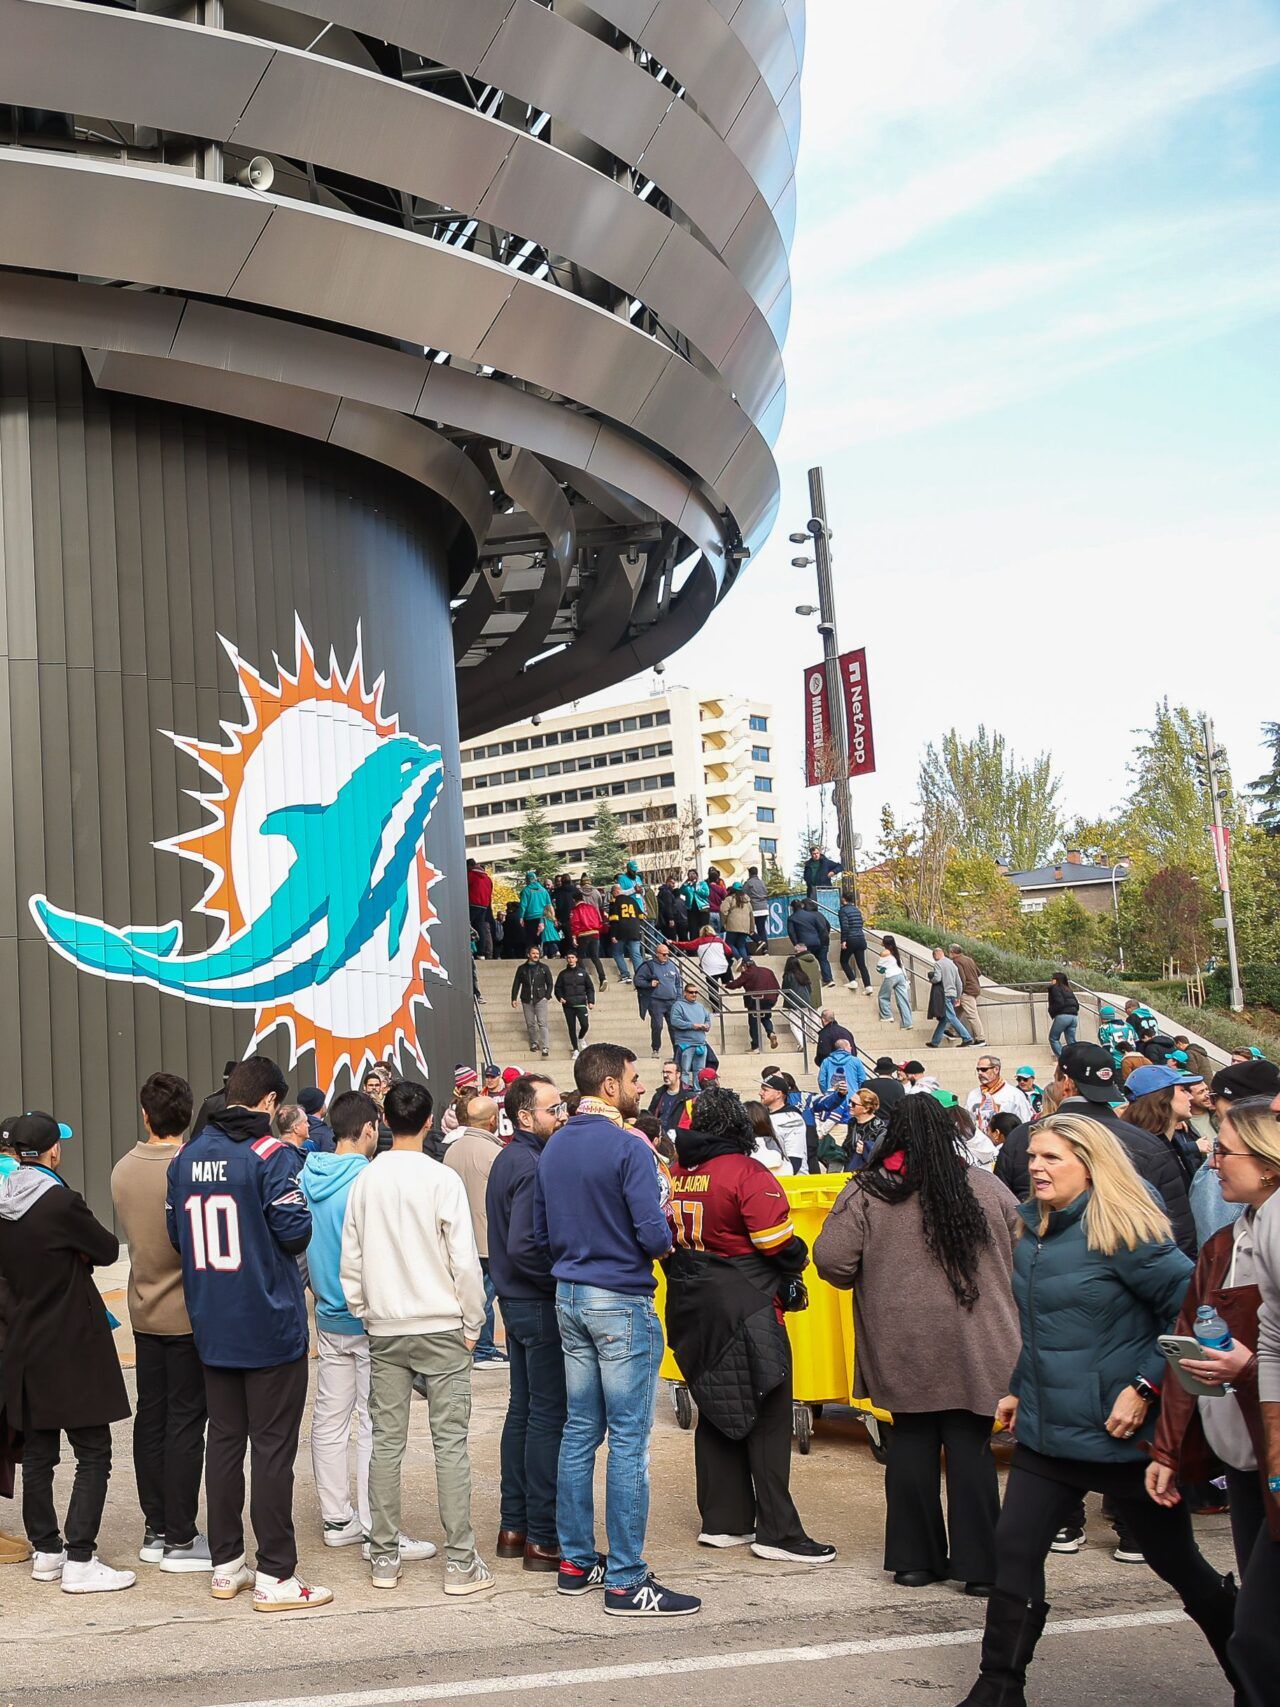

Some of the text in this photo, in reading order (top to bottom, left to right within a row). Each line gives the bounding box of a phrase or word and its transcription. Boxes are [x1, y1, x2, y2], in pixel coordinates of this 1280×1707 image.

[812, 696, 824, 748] MADDEN
[851, 685, 865, 764] NetApp
[621, 903, 636, 918] 24
[191, 1160, 228, 1182] MAYE
[184, 1193, 242, 1272] 10
[671, 1200, 705, 1251] 17
[587, 1565, 605, 1583] AX
[632, 1586, 663, 1612] AX
